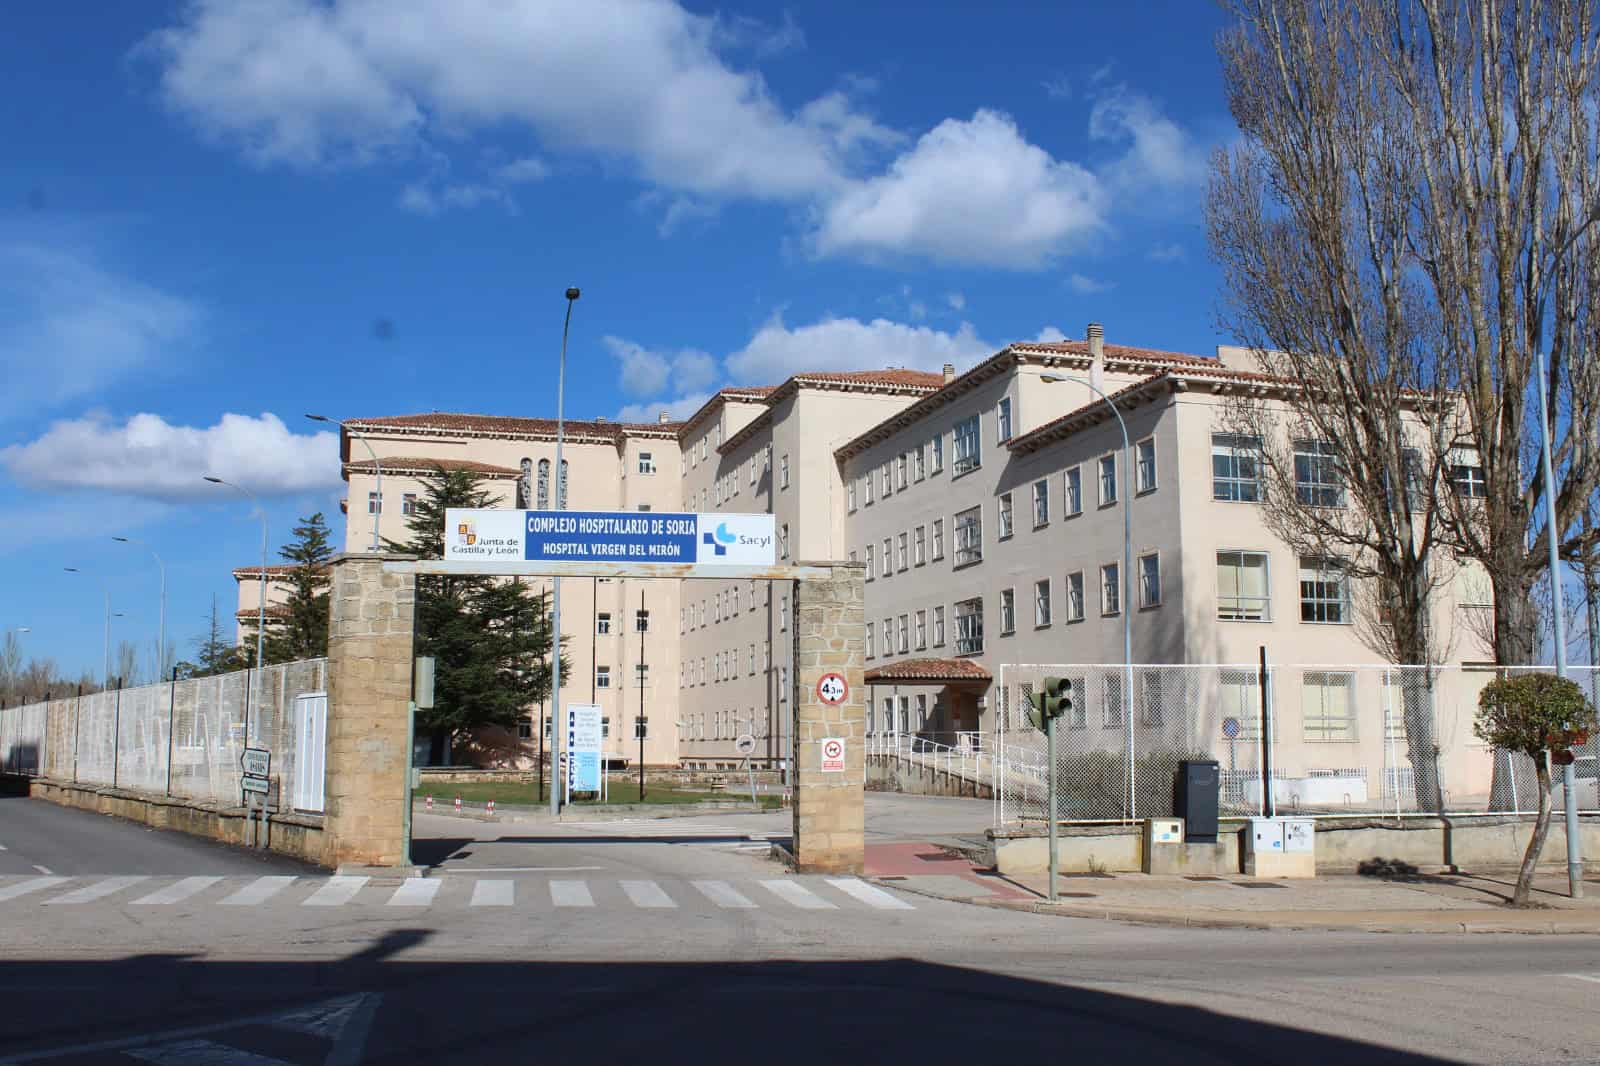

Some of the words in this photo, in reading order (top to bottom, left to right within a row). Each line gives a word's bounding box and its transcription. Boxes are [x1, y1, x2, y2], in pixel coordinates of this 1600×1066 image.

[528, 518, 577, 533] COMPLEJO
[579, 518, 649, 535] HOSPITALARIO
[652, 519, 664, 535] DE
[666, 519, 696, 535] SORIA
[543, 543, 589, 555] HOSPITAL
[591, 543, 627, 556] VIRGEN
[629, 544, 647, 556] DEL
[649, 541, 681, 556] MIRÓN
[739, 535, 771, 548] Sacyl
[452, 546, 485, 554] Castilla
[496, 546, 519, 554] León
